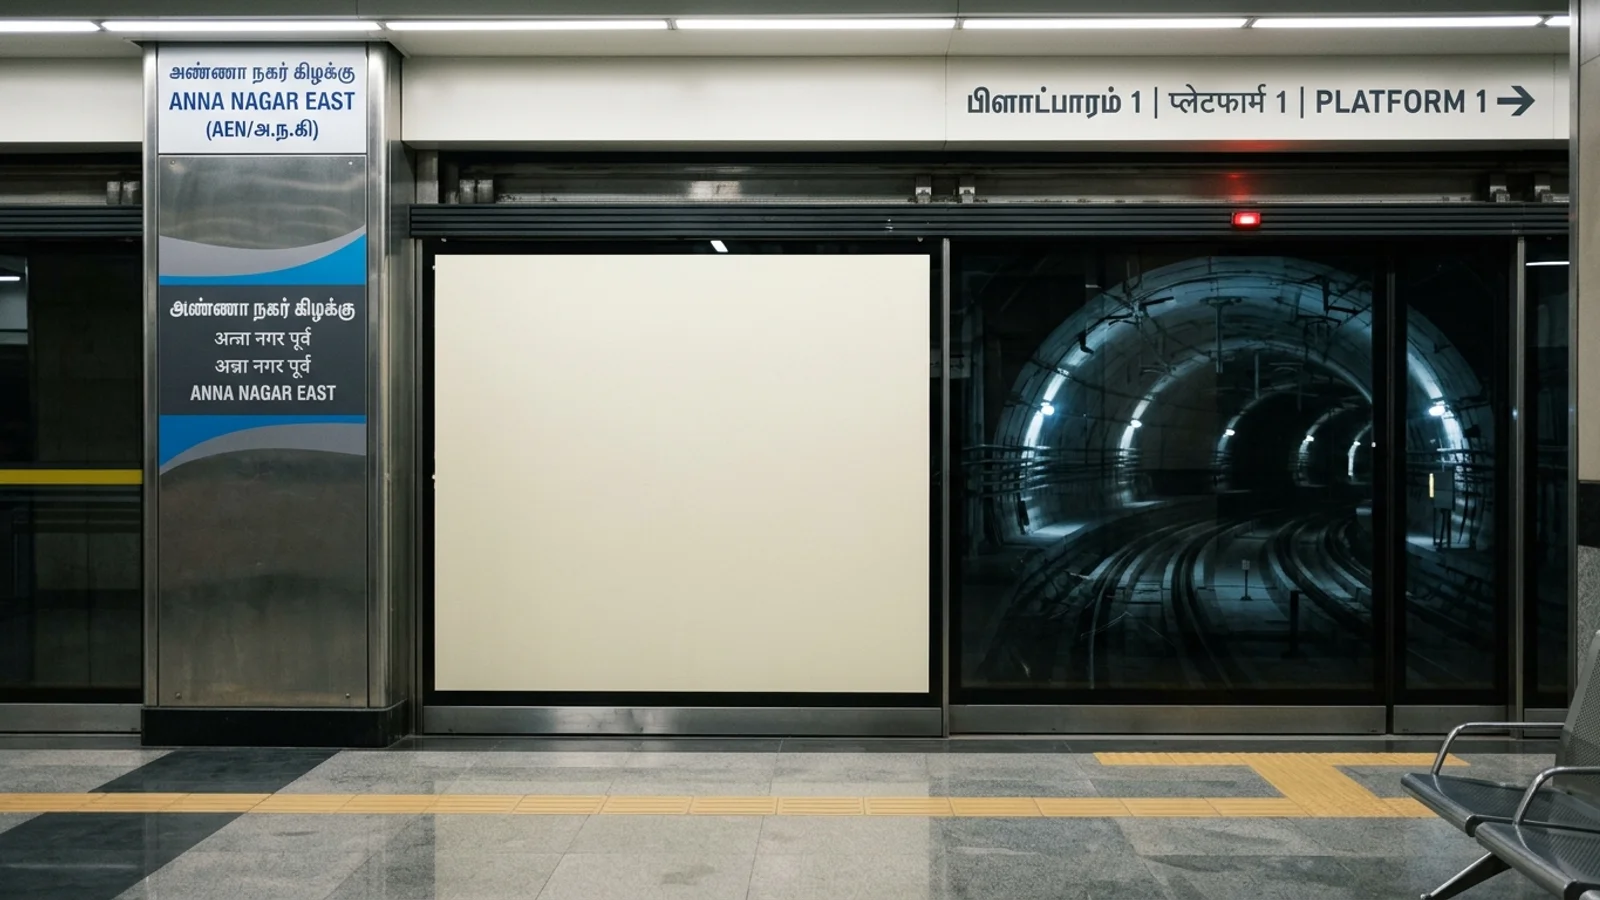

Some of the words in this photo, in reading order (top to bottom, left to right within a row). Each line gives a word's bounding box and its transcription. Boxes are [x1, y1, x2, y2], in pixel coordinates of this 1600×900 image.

[169, 61, 247, 80] அண்ணா
[252, 62, 288, 85] நகர்
[293, 61, 356, 86] கிழக்கு
[169, 91, 225, 111] ANNA
[231, 91, 298, 111] NAGAR
[306, 91, 356, 111] EAST
[967, 86, 1122, 119] பிளாட்பாரம்
[1131, 90, 1141, 114] 1
[1168, 84, 1267, 114] प्लेटफार्म
[1276, 90, 1286, 114] 1
[1316, 89, 1466, 114] PLATFORM
[1476, 89, 1486, 114] 1
[252, 296, 290, 322] நகர்
[294, 296, 356, 323] கிழக்கு
[254, 331, 285, 347] नगर
[288, 326, 312, 351] पूर्व
[252, 359, 284, 374] नगर
[287, 354, 312, 379] पूर्व
[190, 384, 235, 401] ANNA
[238, 384, 293, 401] NAGAR
[297, 384, 337, 401] EAST
